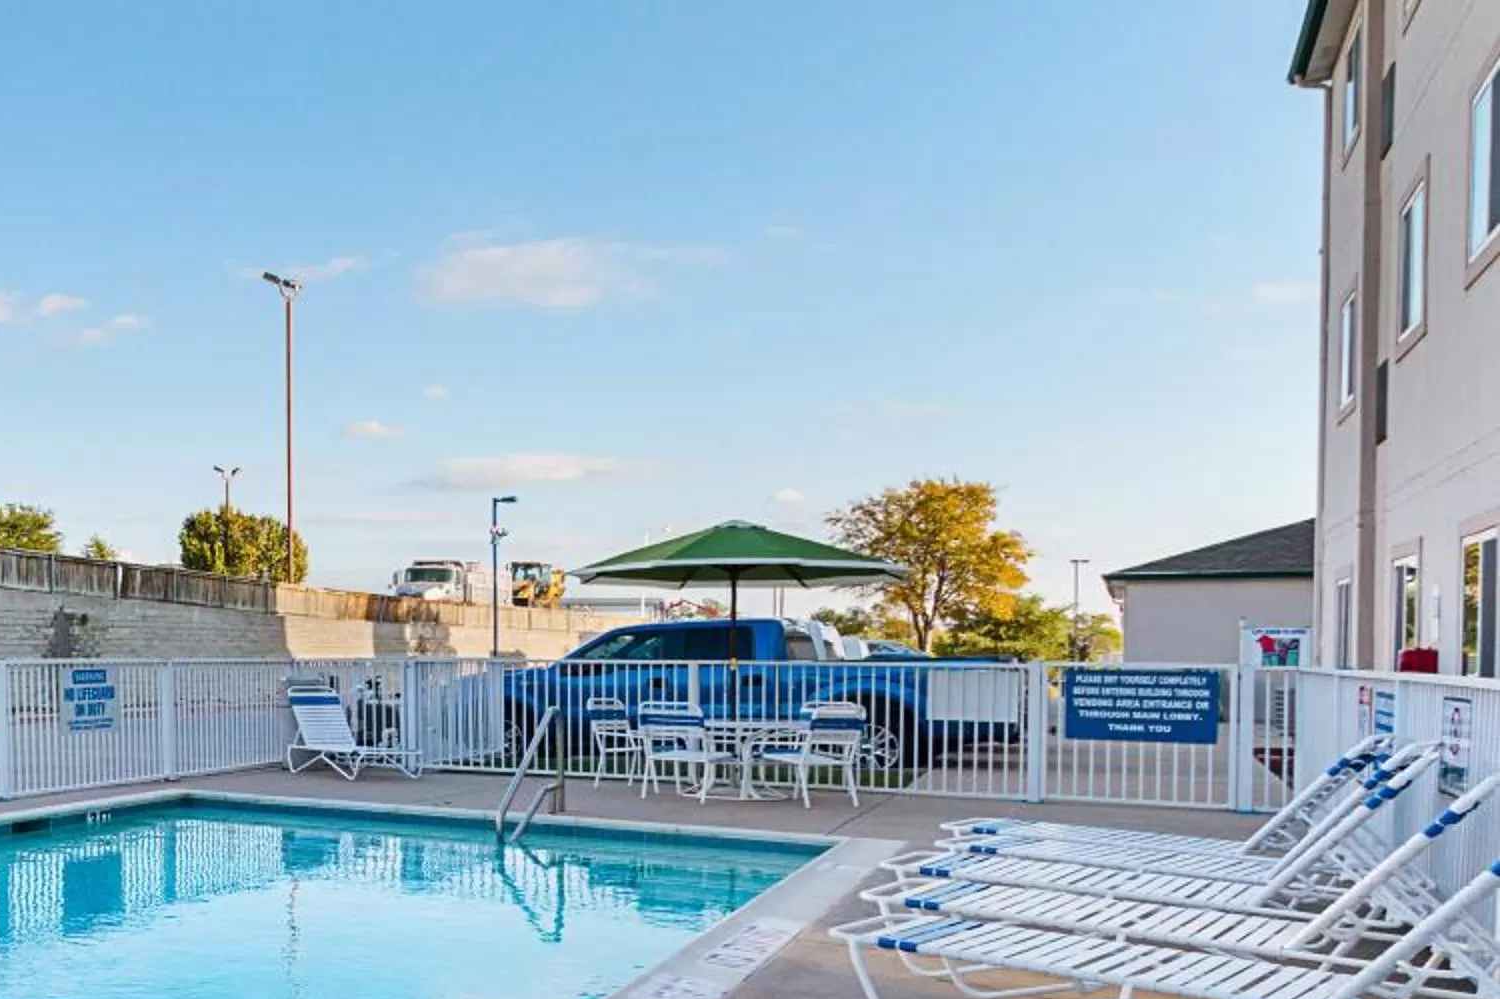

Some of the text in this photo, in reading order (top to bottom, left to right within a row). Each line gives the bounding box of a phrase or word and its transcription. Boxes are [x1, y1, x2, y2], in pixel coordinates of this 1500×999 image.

[1075, 675, 1208, 686] PLEASE DRY YOURSELF COMPLETELY
[63, 686, 115, 702] NO LIFEGUARD
[1073, 686, 1100, 695] BEFORE
[1101, 687, 1137, 697] ENTERING
[1138, 687, 1172, 698] BUILDING
[75, 702, 106, 717] ON DUTY
[1073, 697, 1210, 710] VENDING AREA ENTRANCE OR
[1078, 709, 1204, 721] THROUGH MAIN LOBBY.
[1107, 723, 1172, 733] THANK YOU
